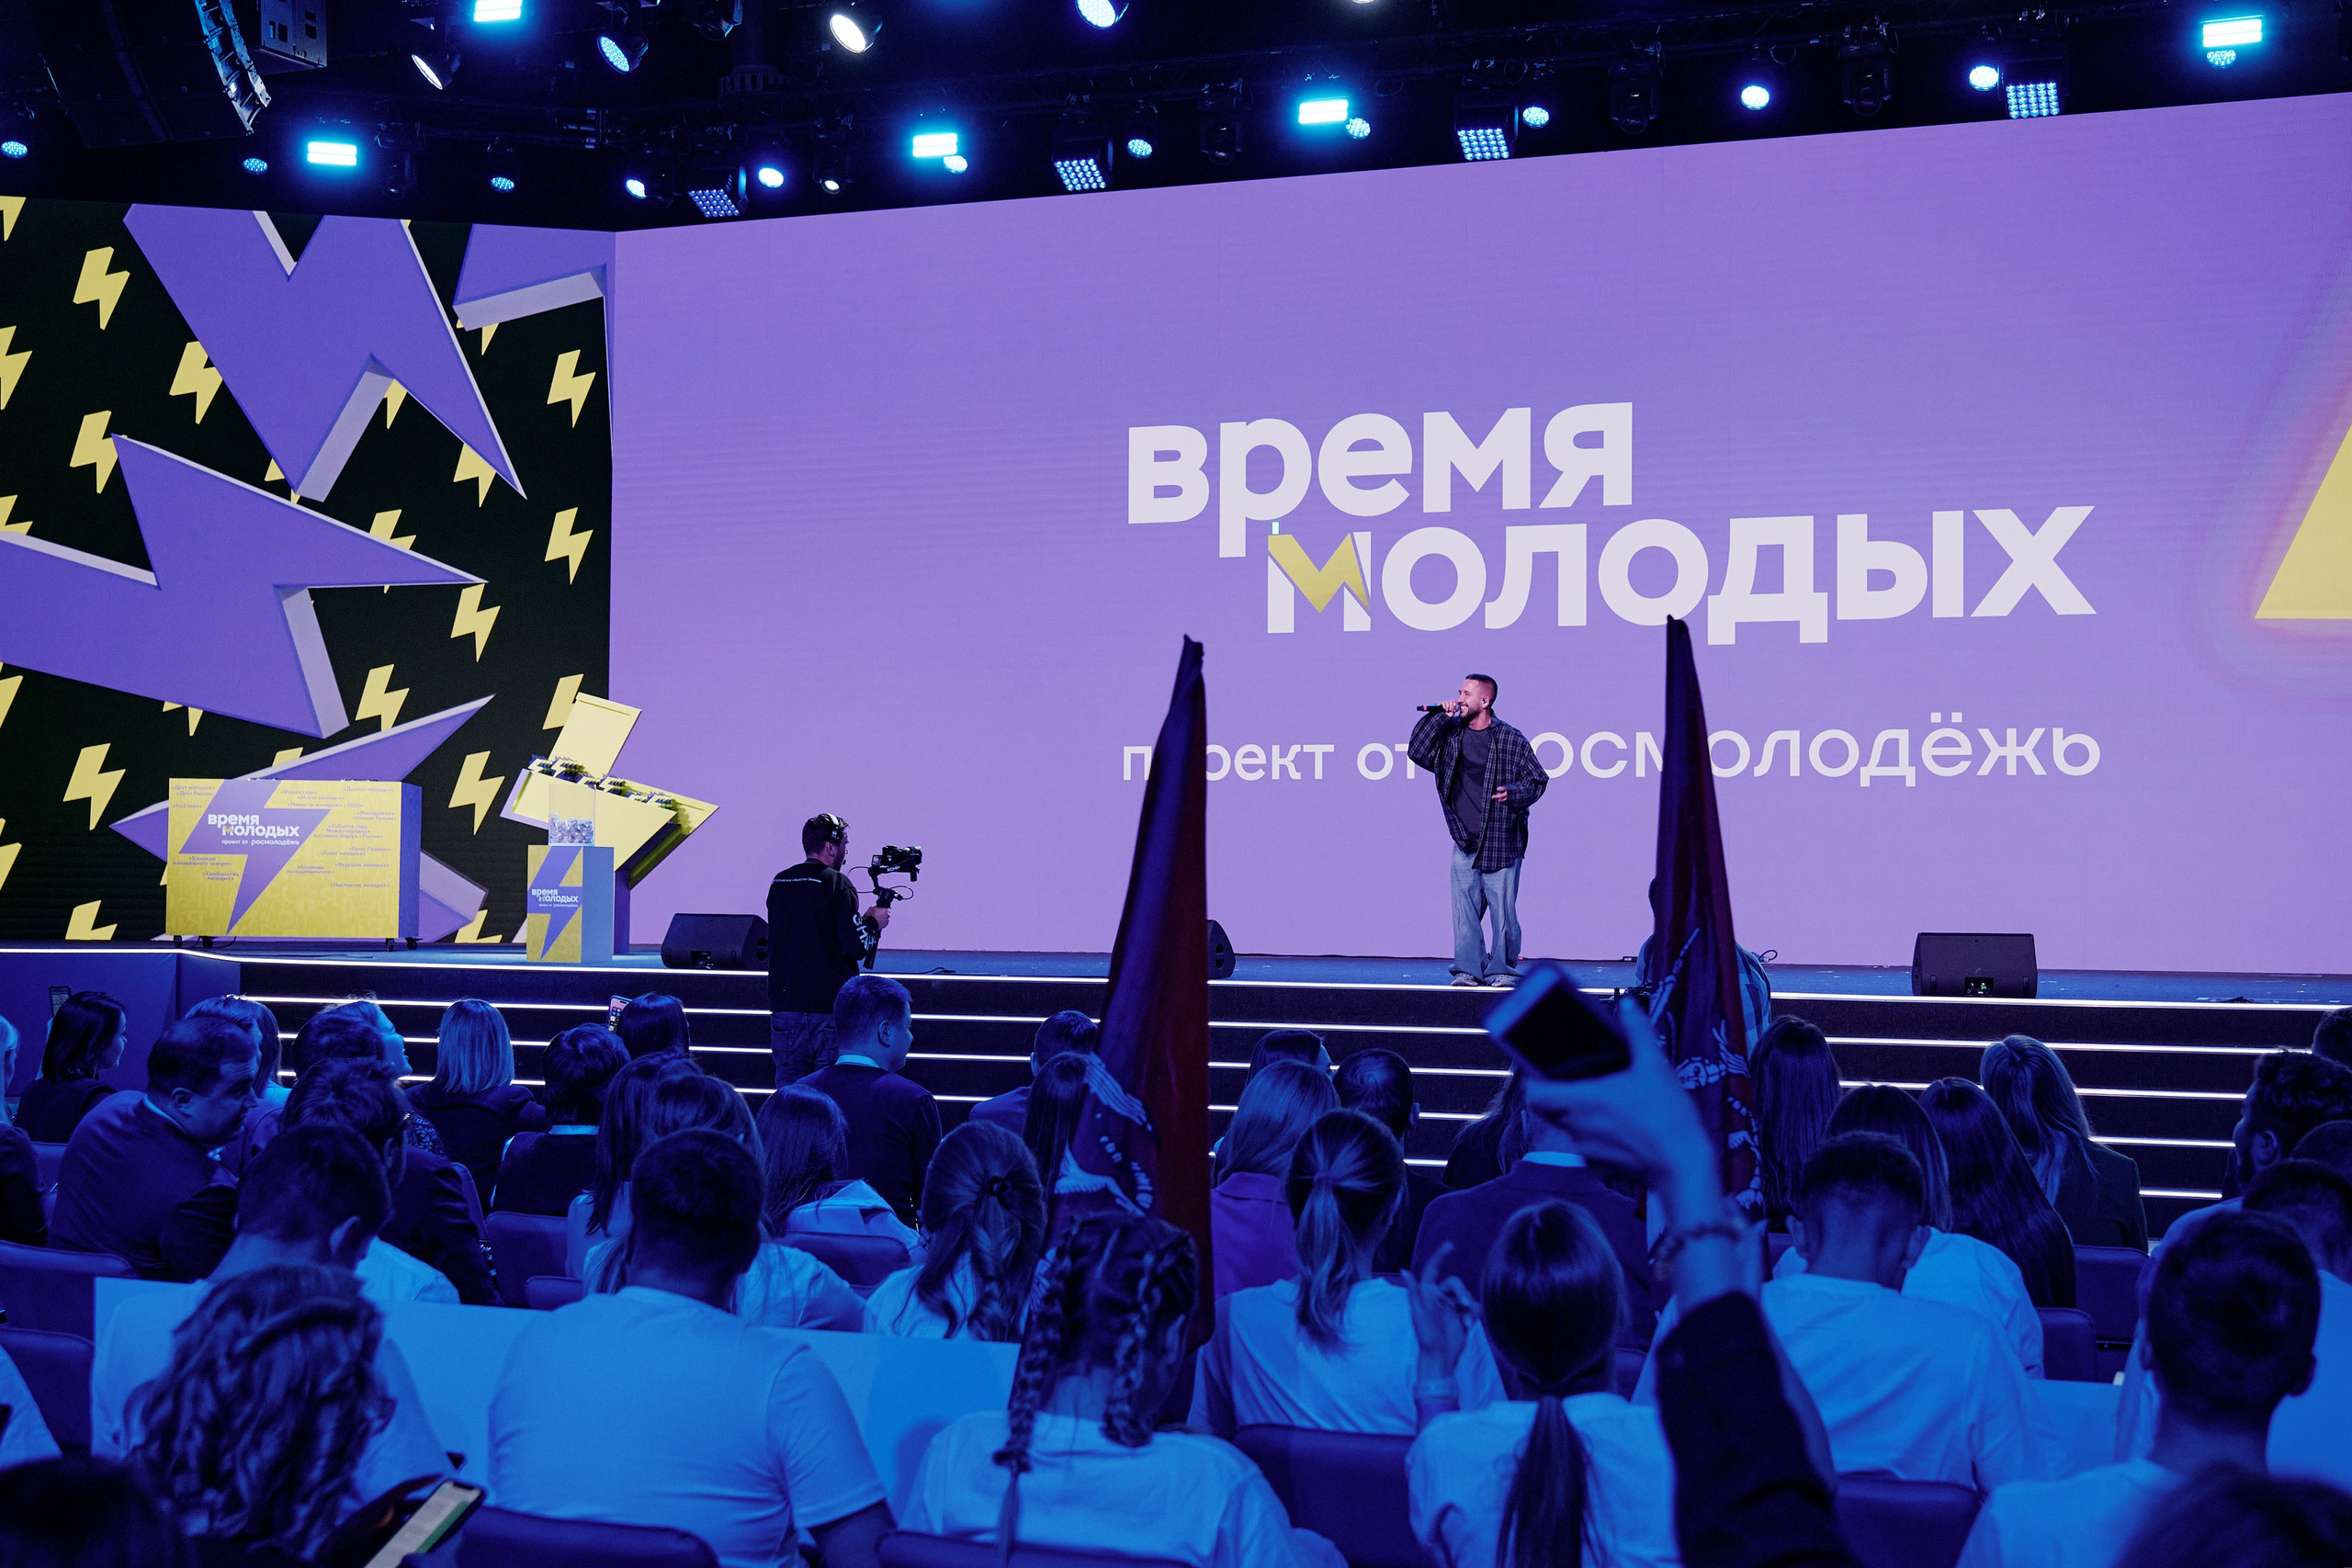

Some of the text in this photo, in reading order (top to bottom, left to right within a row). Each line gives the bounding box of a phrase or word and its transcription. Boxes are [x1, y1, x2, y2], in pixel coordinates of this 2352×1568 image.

[1126, 401, 1634, 558] время
[1267, 506, 2098, 646] молодых
[1123, 743, 1335, 781] поект
[1530, 711, 2101, 787] осолодёжь
[208, 814, 260, 829] время
[222, 825, 300, 839] молодых
[251, 838, 300, 847] росмолодёжь
[531, 888, 559, 898] время
[538, 895, 579, 904] молодых
